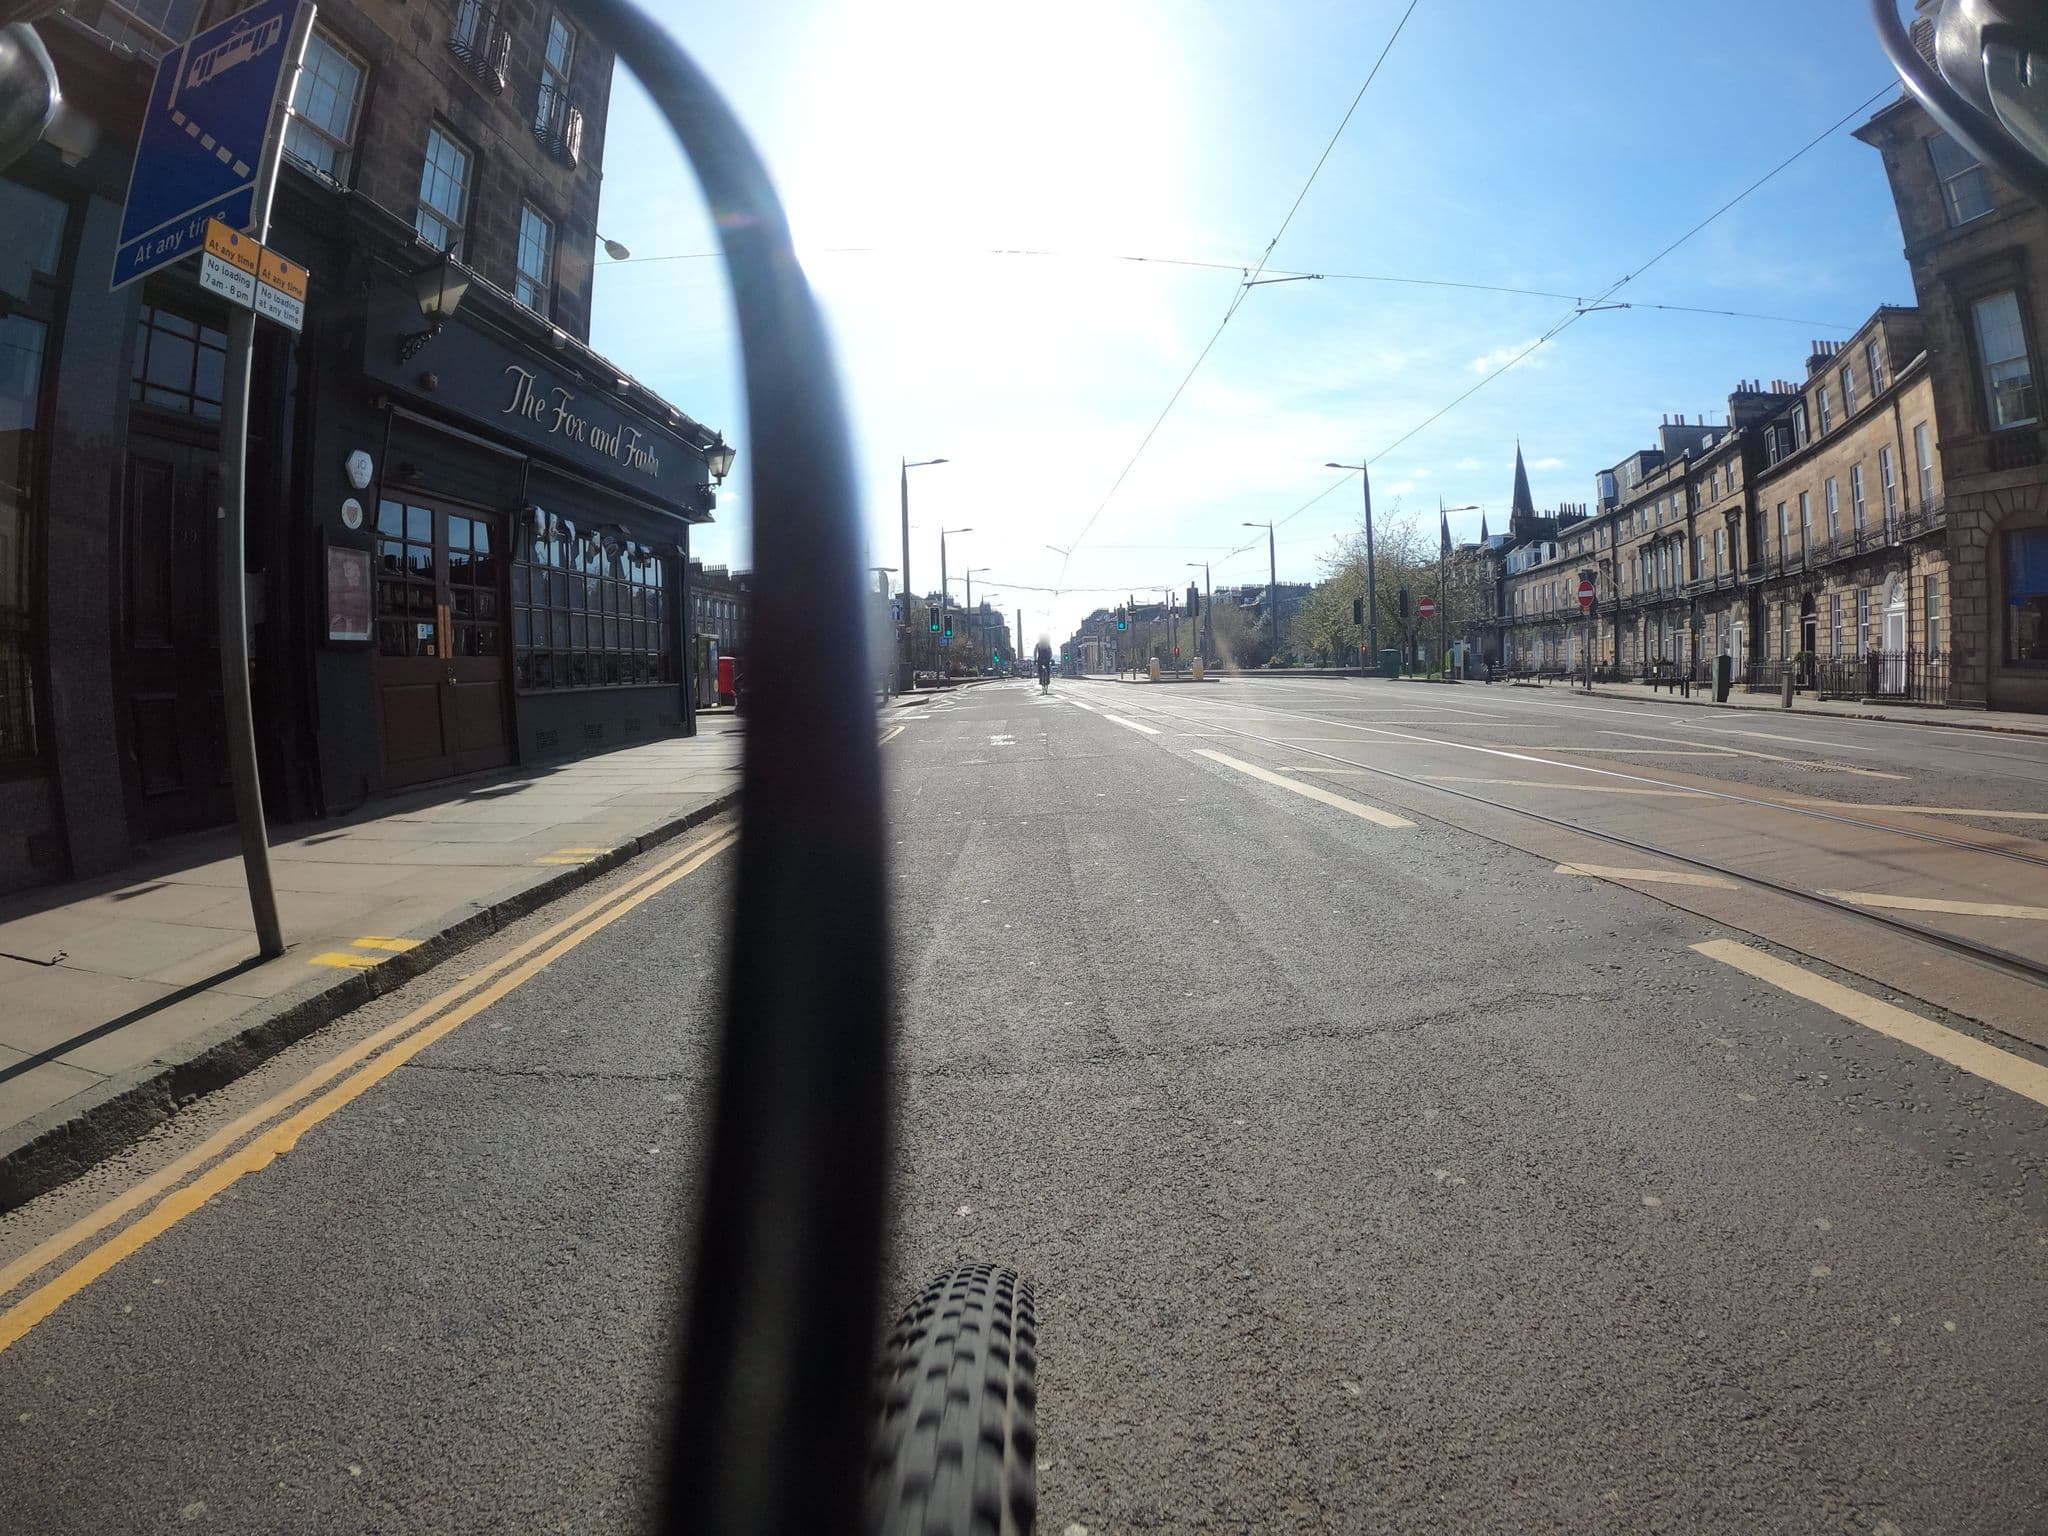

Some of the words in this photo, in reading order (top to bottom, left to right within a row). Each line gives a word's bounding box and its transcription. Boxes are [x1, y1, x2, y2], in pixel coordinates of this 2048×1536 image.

[134, 243, 152, 266] At
[156, 230, 184, 256] any
[189, 210, 226, 238] tie
[208, 239, 219, 251] At
[221, 247, 236, 261] any
[237, 253, 254, 270] time
[207, 258, 220, 272] No
[221, 265, 251, 288] loading
[262, 269, 271, 279] At
[273, 277, 285, 288] any
[287, 281, 303, 296] time
[259, 299, 267, 309] at
[269, 304, 282, 317] any
[284, 308, 299, 324] time
[260, 287, 272, 299] No
[274, 293, 300, 314] loading
[502, 365, 546, 421] The
[548, 387, 588, 442] Fox
[590, 424, 623, 460] and
